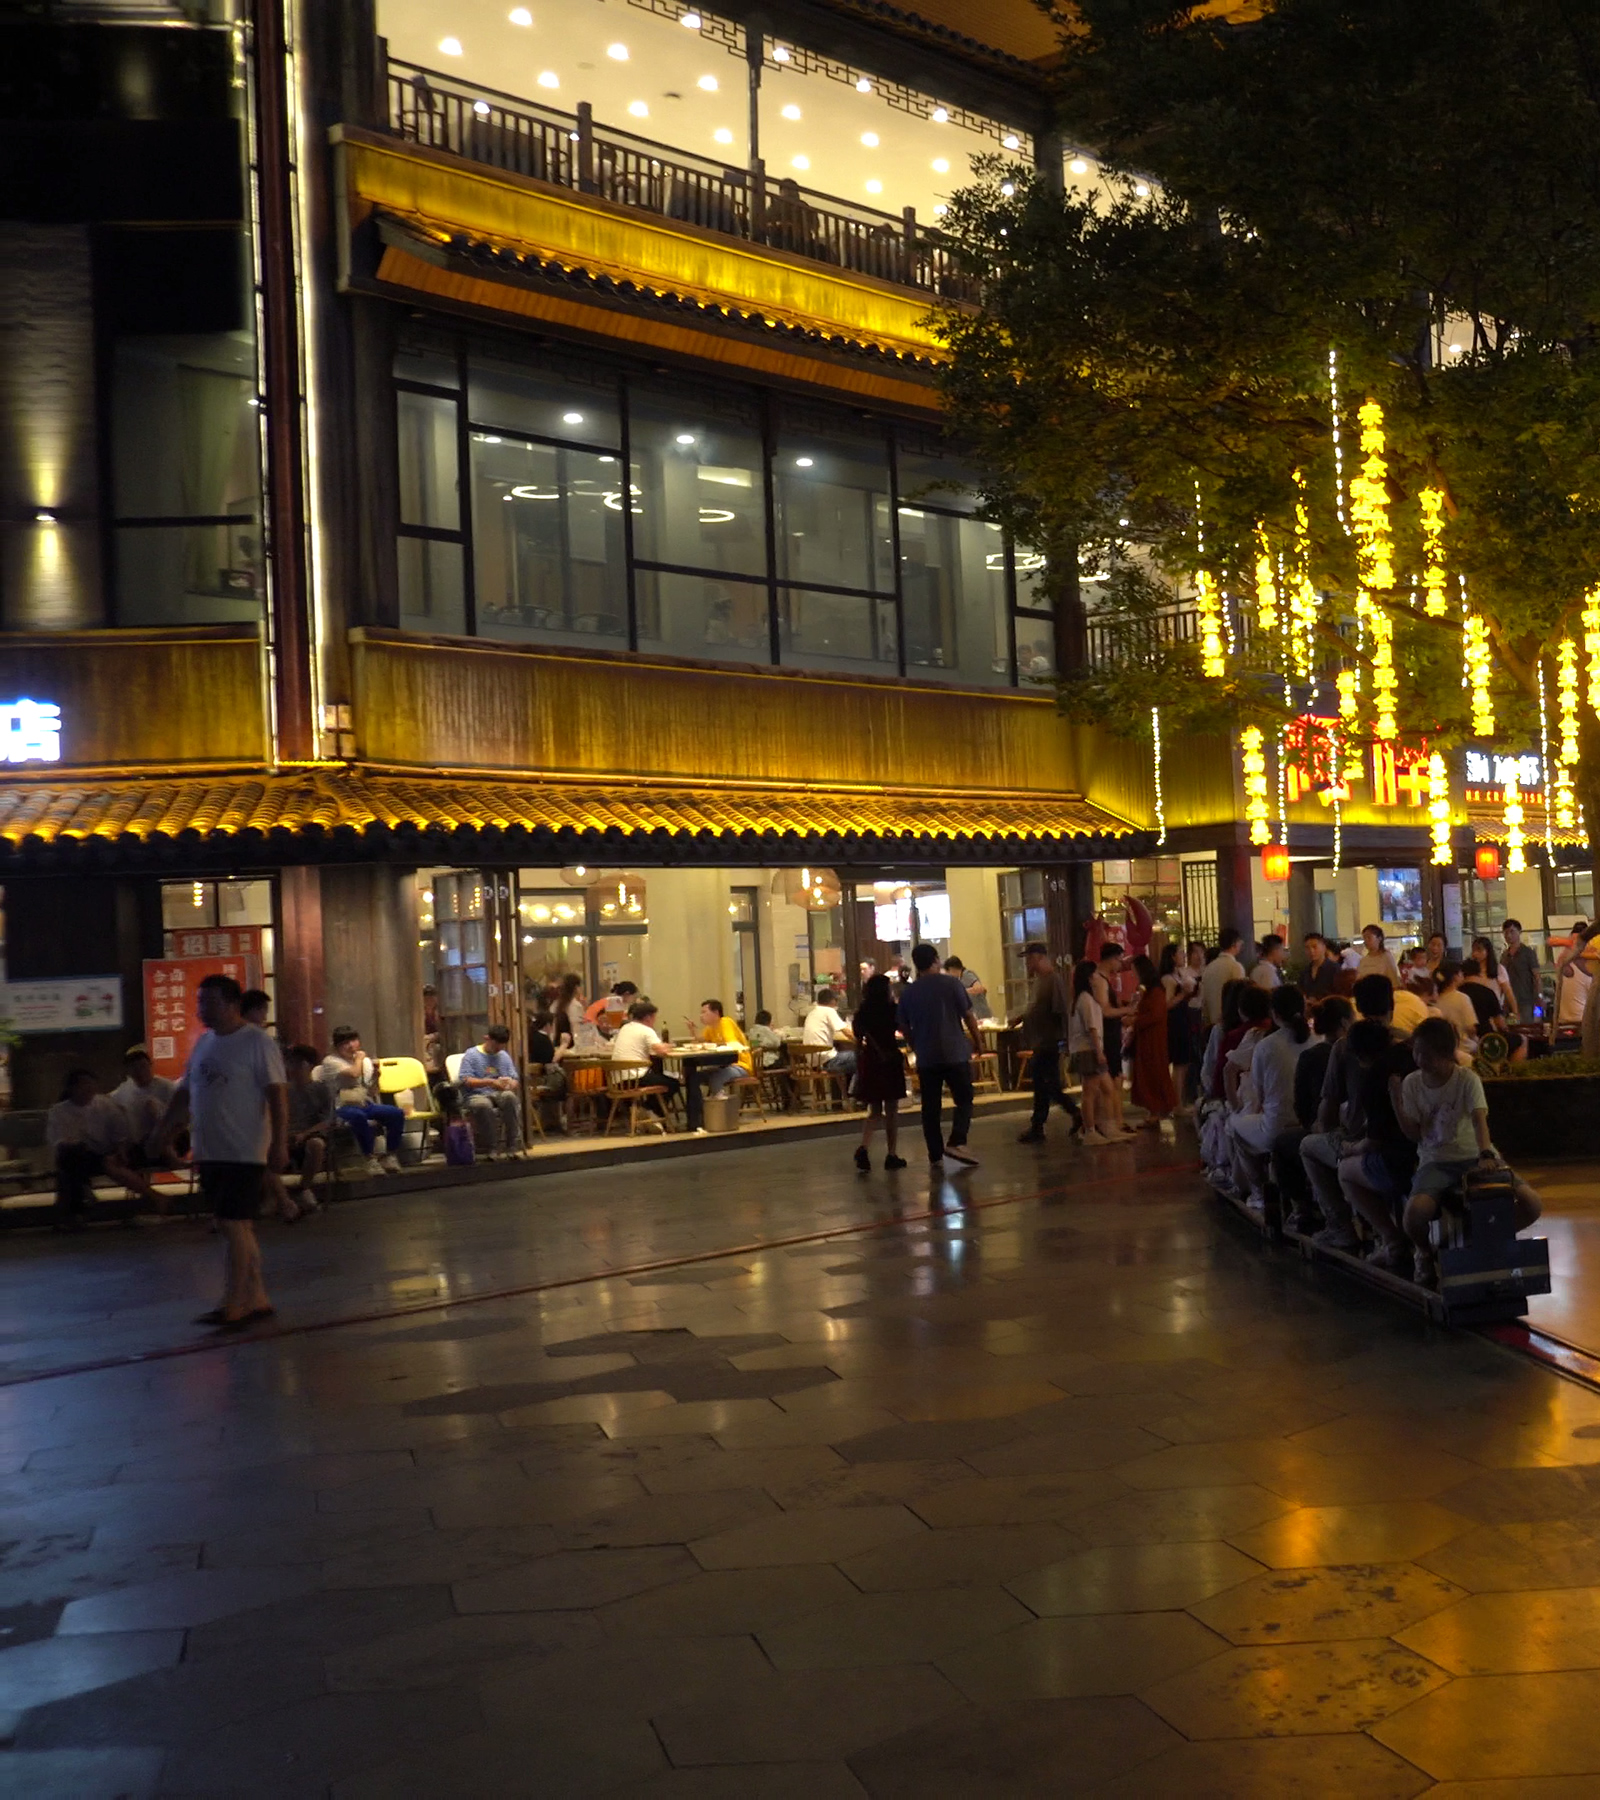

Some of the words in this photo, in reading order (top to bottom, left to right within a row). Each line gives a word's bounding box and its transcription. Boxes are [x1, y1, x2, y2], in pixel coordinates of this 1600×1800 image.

[0, 699, 62, 764] 店
[152, 969, 168, 1032] 合肥龙虾
